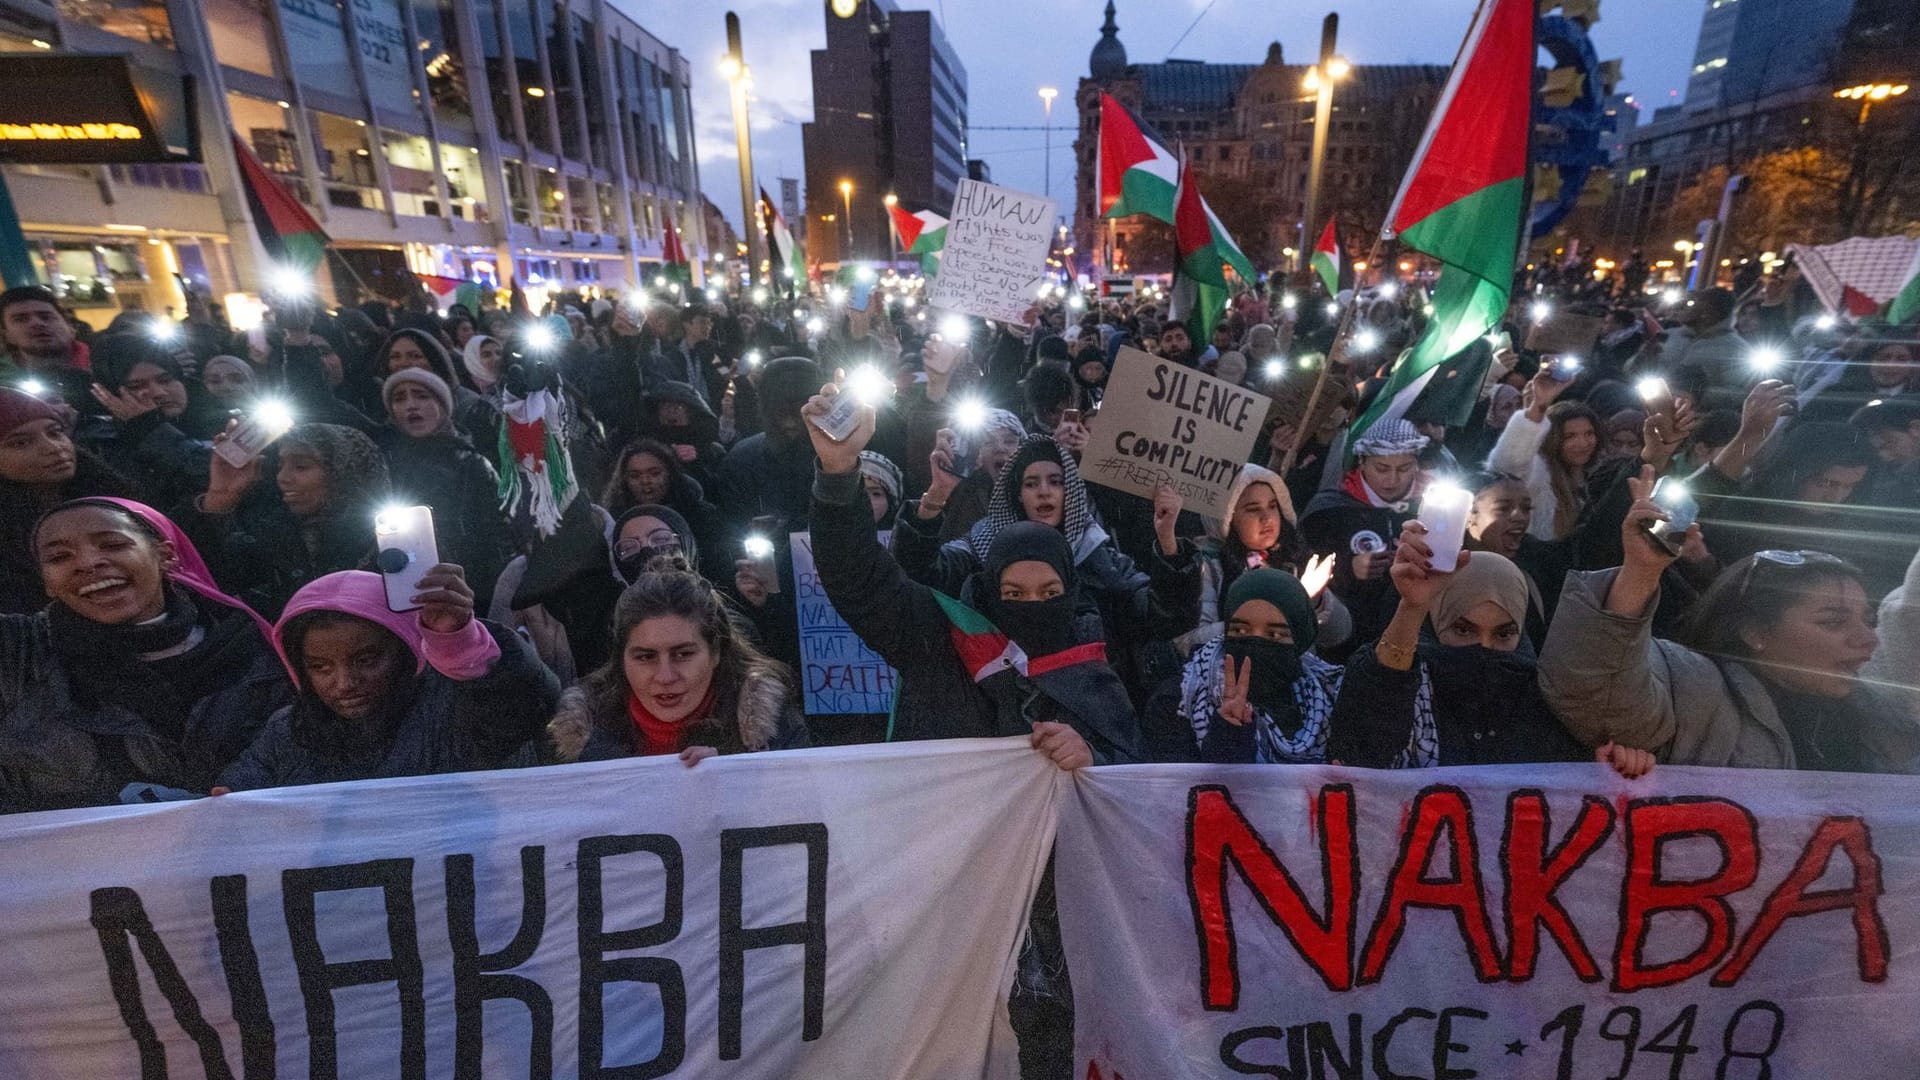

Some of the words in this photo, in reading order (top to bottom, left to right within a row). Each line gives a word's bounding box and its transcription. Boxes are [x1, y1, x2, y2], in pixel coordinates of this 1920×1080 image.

[957, 180, 1046, 225] HUMAN
[956, 218, 1010, 237] rights
[1016, 231, 1045, 244] was
[948, 245, 998, 263] speech
[1146, 364, 1254, 432] SILENCE
[1171, 416, 1197, 444] IS
[1115, 431, 1244, 491] COMPLICITY
[802, 636, 848, 660] THAT
[807, 664, 894, 693] DEATH
[1186, 783, 1891, 1010] NAKBA
[89, 822, 828, 1080] NAKBA
[1219, 1006, 1489, 1080] SINCE
[1540, 999, 1785, 1080] 1948
